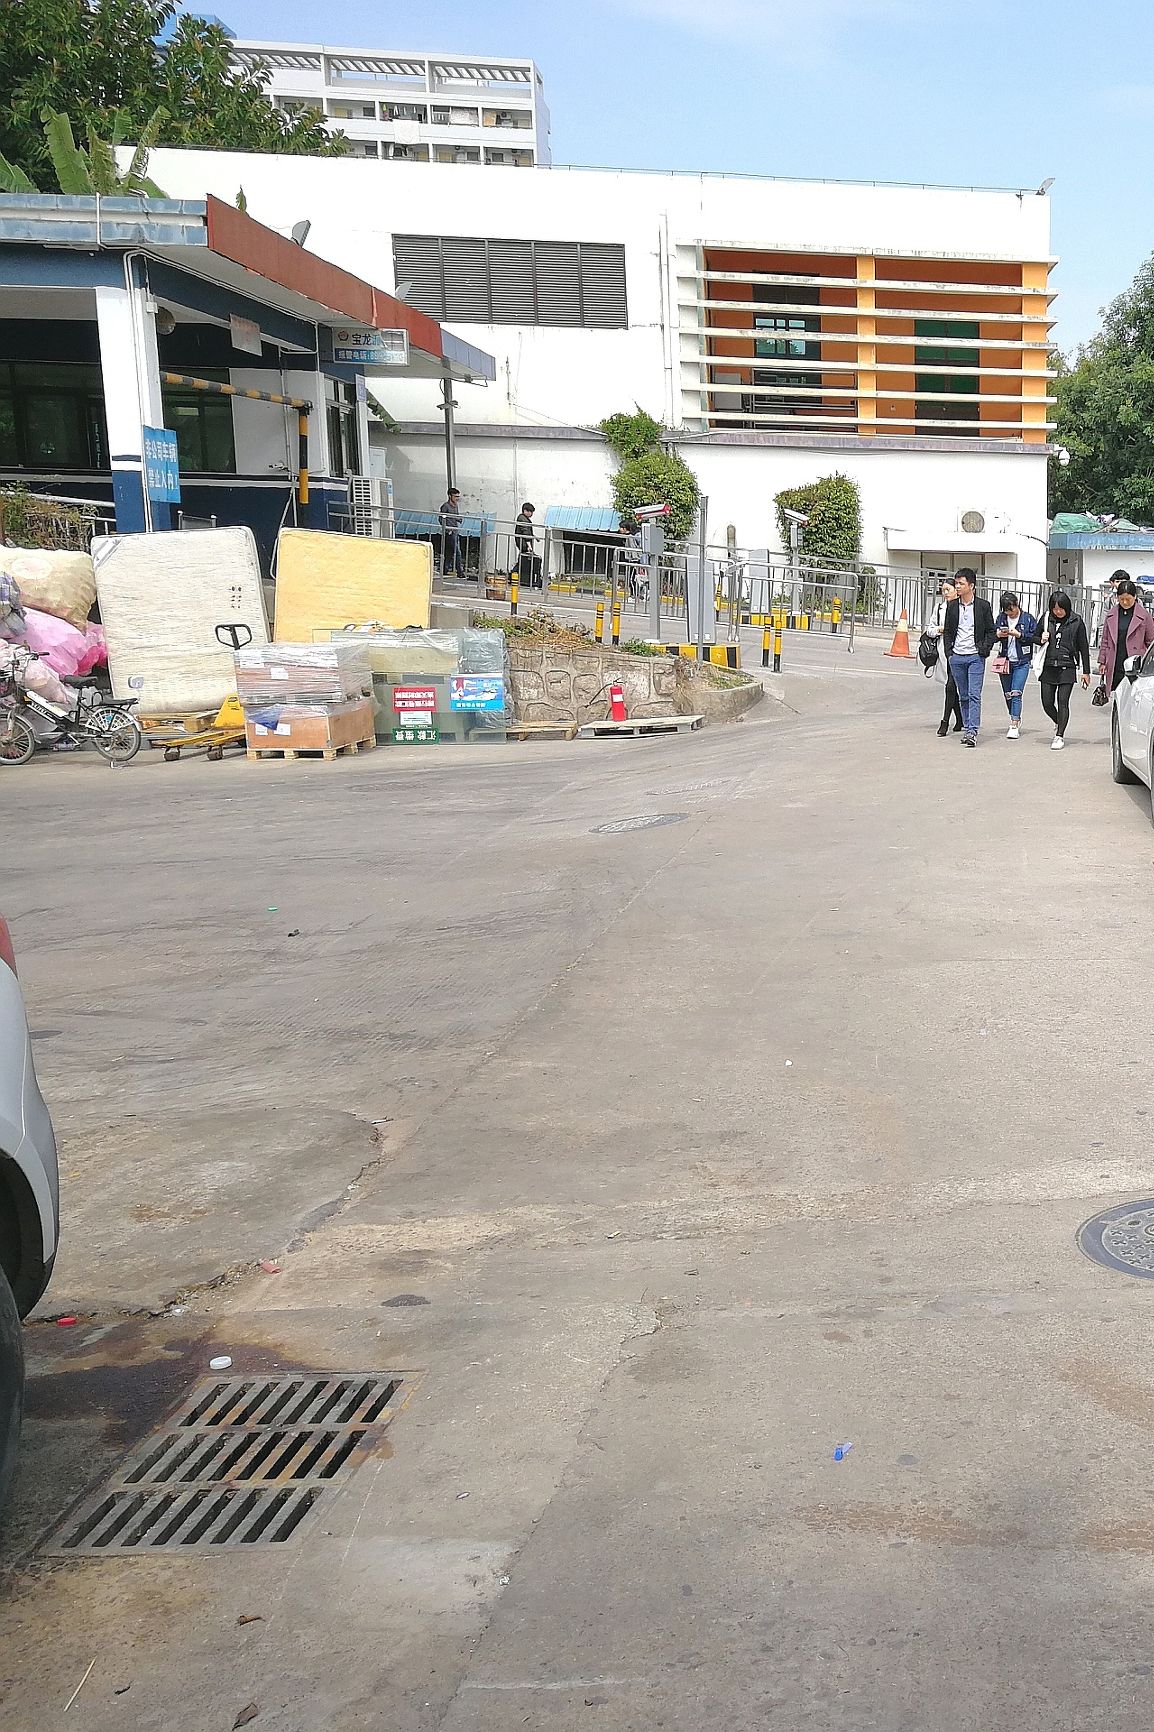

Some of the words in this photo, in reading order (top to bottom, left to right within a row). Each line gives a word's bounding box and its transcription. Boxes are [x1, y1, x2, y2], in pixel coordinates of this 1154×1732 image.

[145, 438, 177, 463] 非公司车辆
